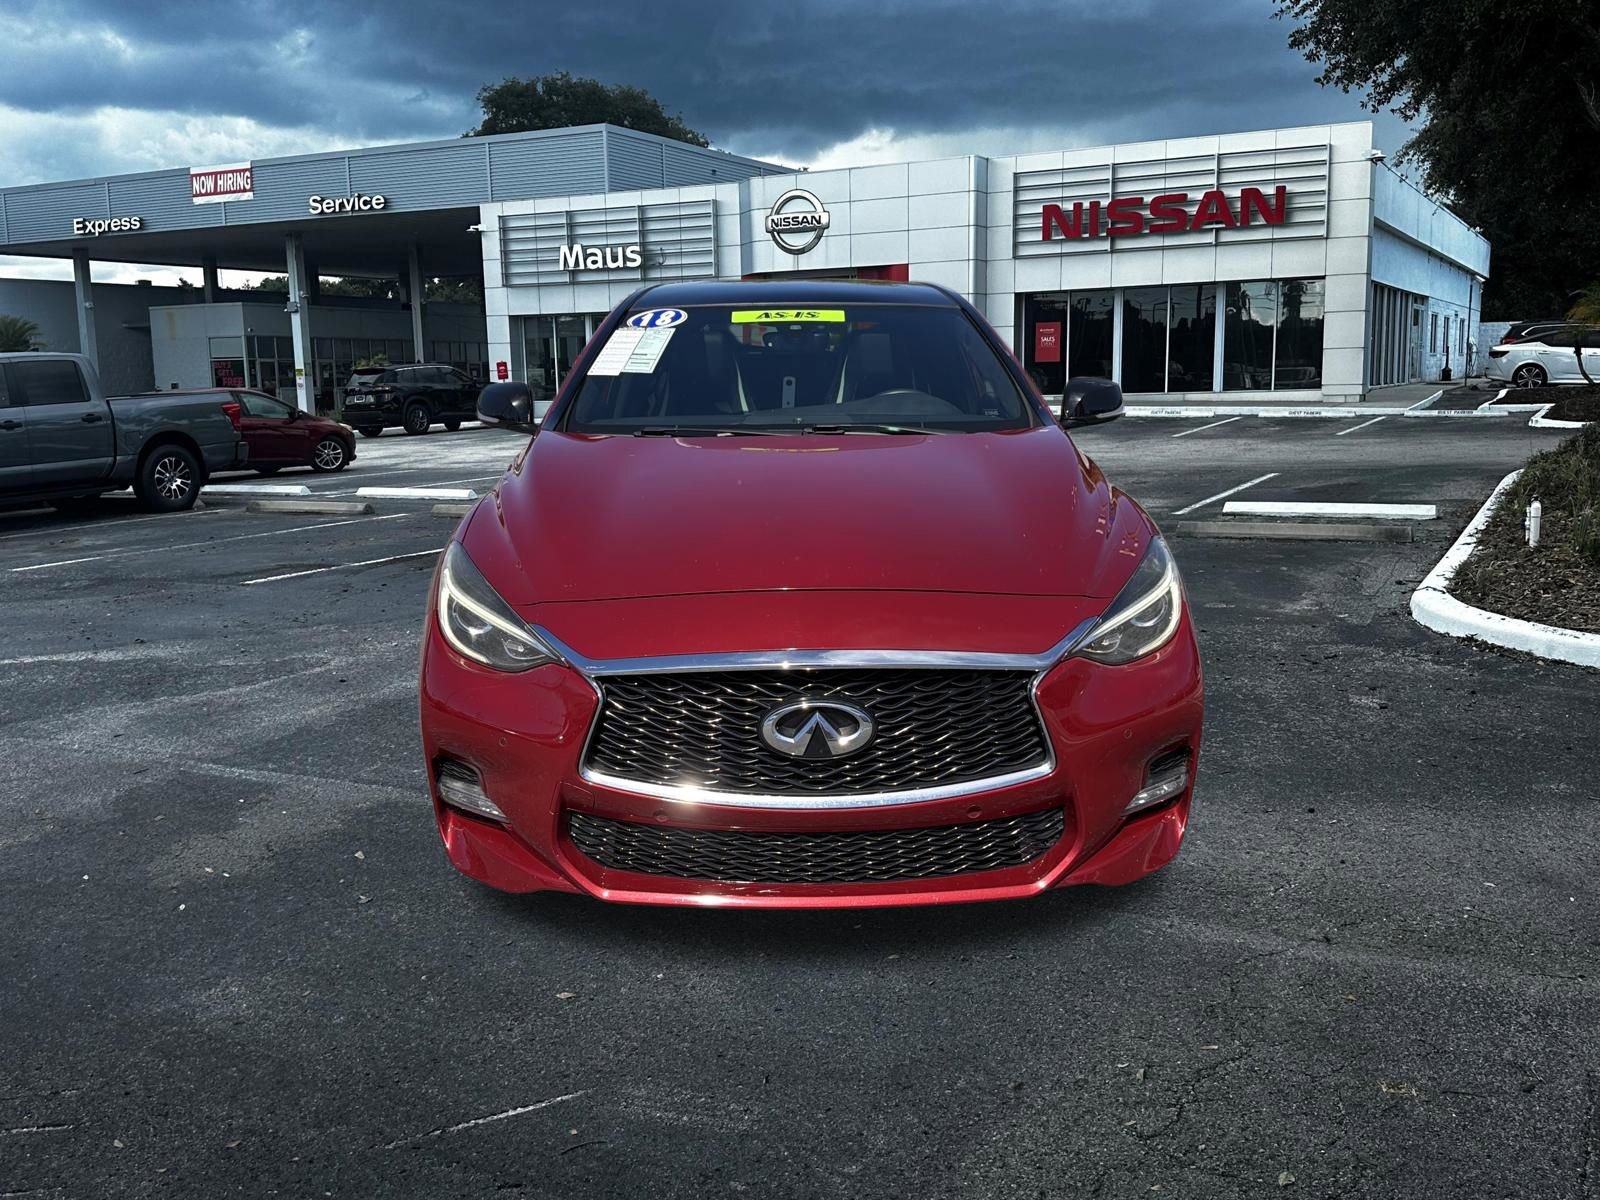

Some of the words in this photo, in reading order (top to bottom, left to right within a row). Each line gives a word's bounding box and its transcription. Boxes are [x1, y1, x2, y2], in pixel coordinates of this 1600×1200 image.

[193, 174, 215, 195] NOW
[217, 170, 251, 192] HIRING
[309, 193, 385, 214] Service
[1041, 185, 1287, 241] NISSAN
[73, 216, 141, 237] Express
[770, 215, 822, 228] NISSAN
[559, 244, 642, 271] Maus
[640, 310, 676, 327] 18
[756, 311, 821, 319] AS-IS
